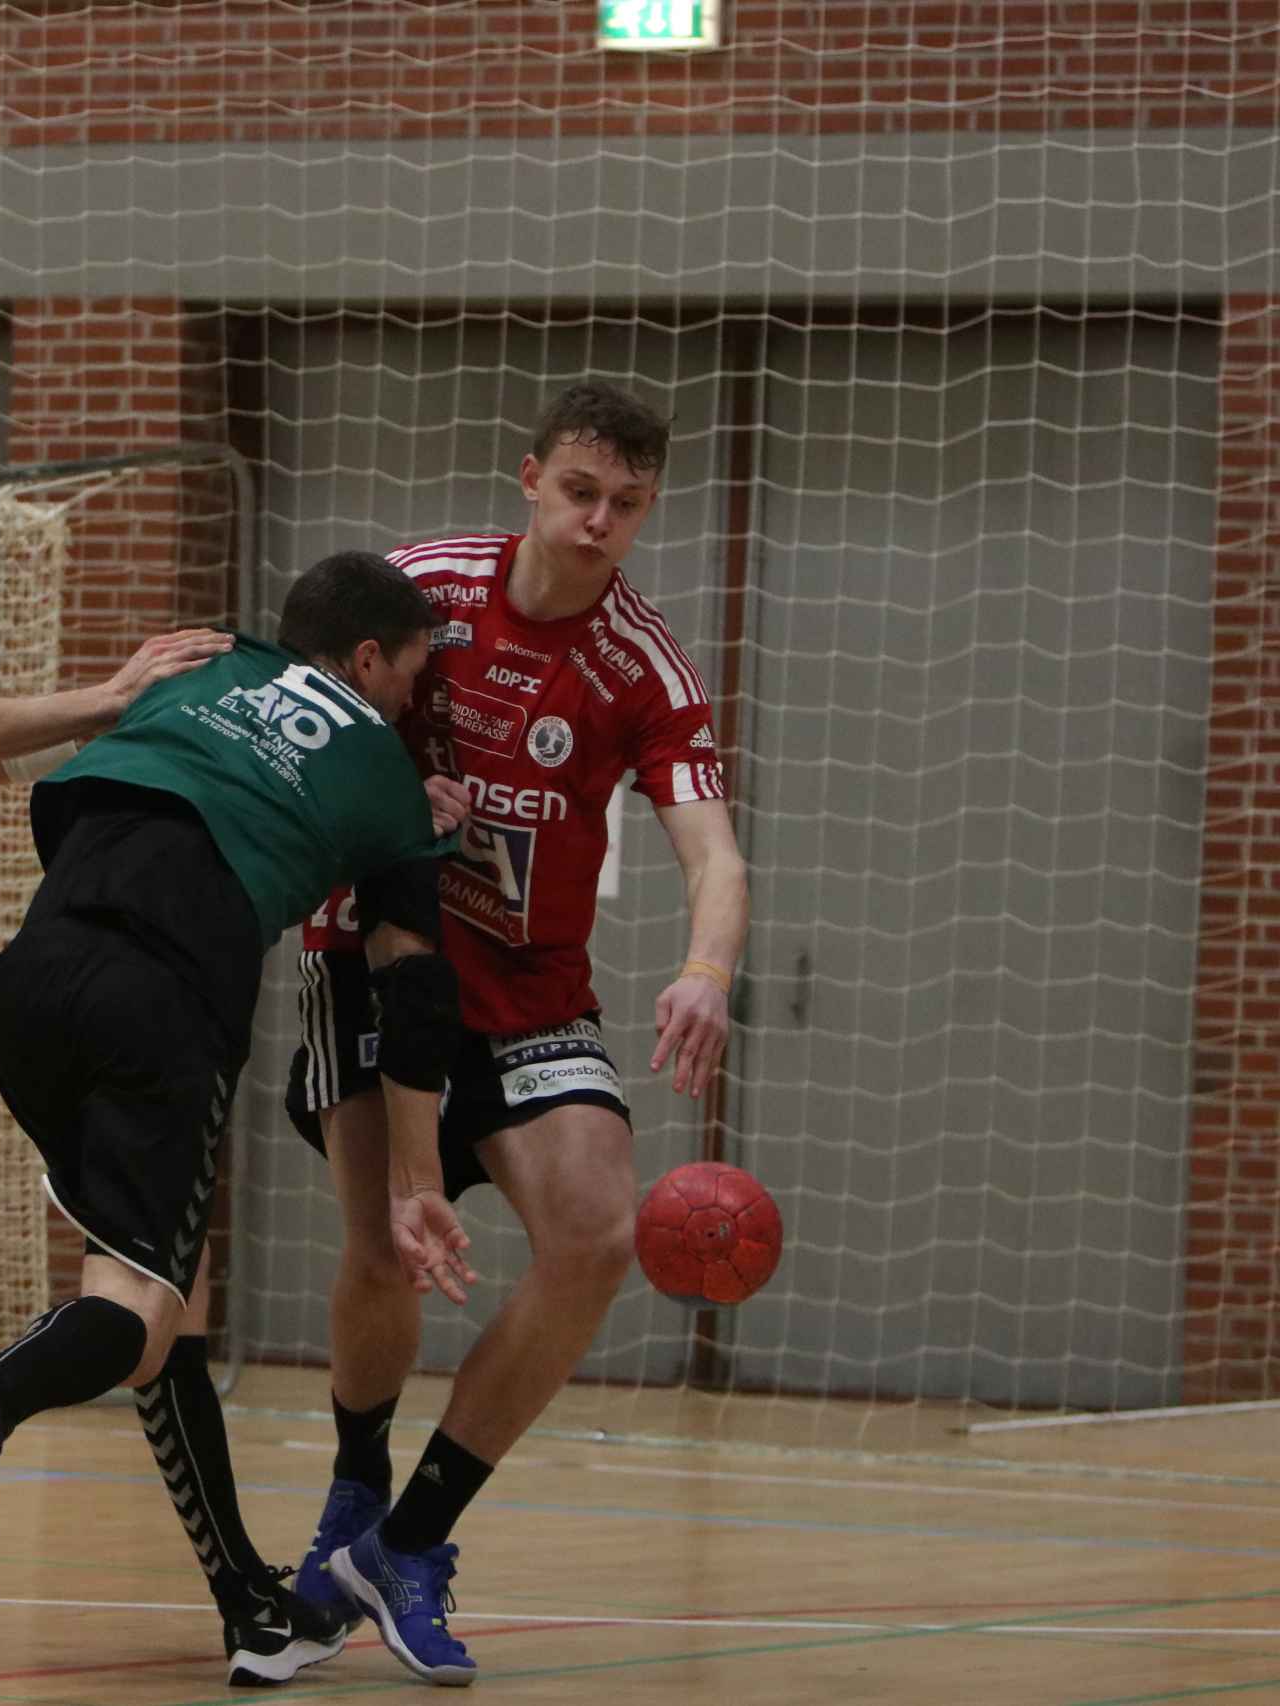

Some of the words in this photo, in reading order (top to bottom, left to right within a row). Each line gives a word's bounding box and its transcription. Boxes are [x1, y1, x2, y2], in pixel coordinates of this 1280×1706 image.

[422, 583, 489, 604] ENTAUR
[449, 713, 511, 741] PAREKASSE
[505, 1040, 606, 1065] SHIPPIN
